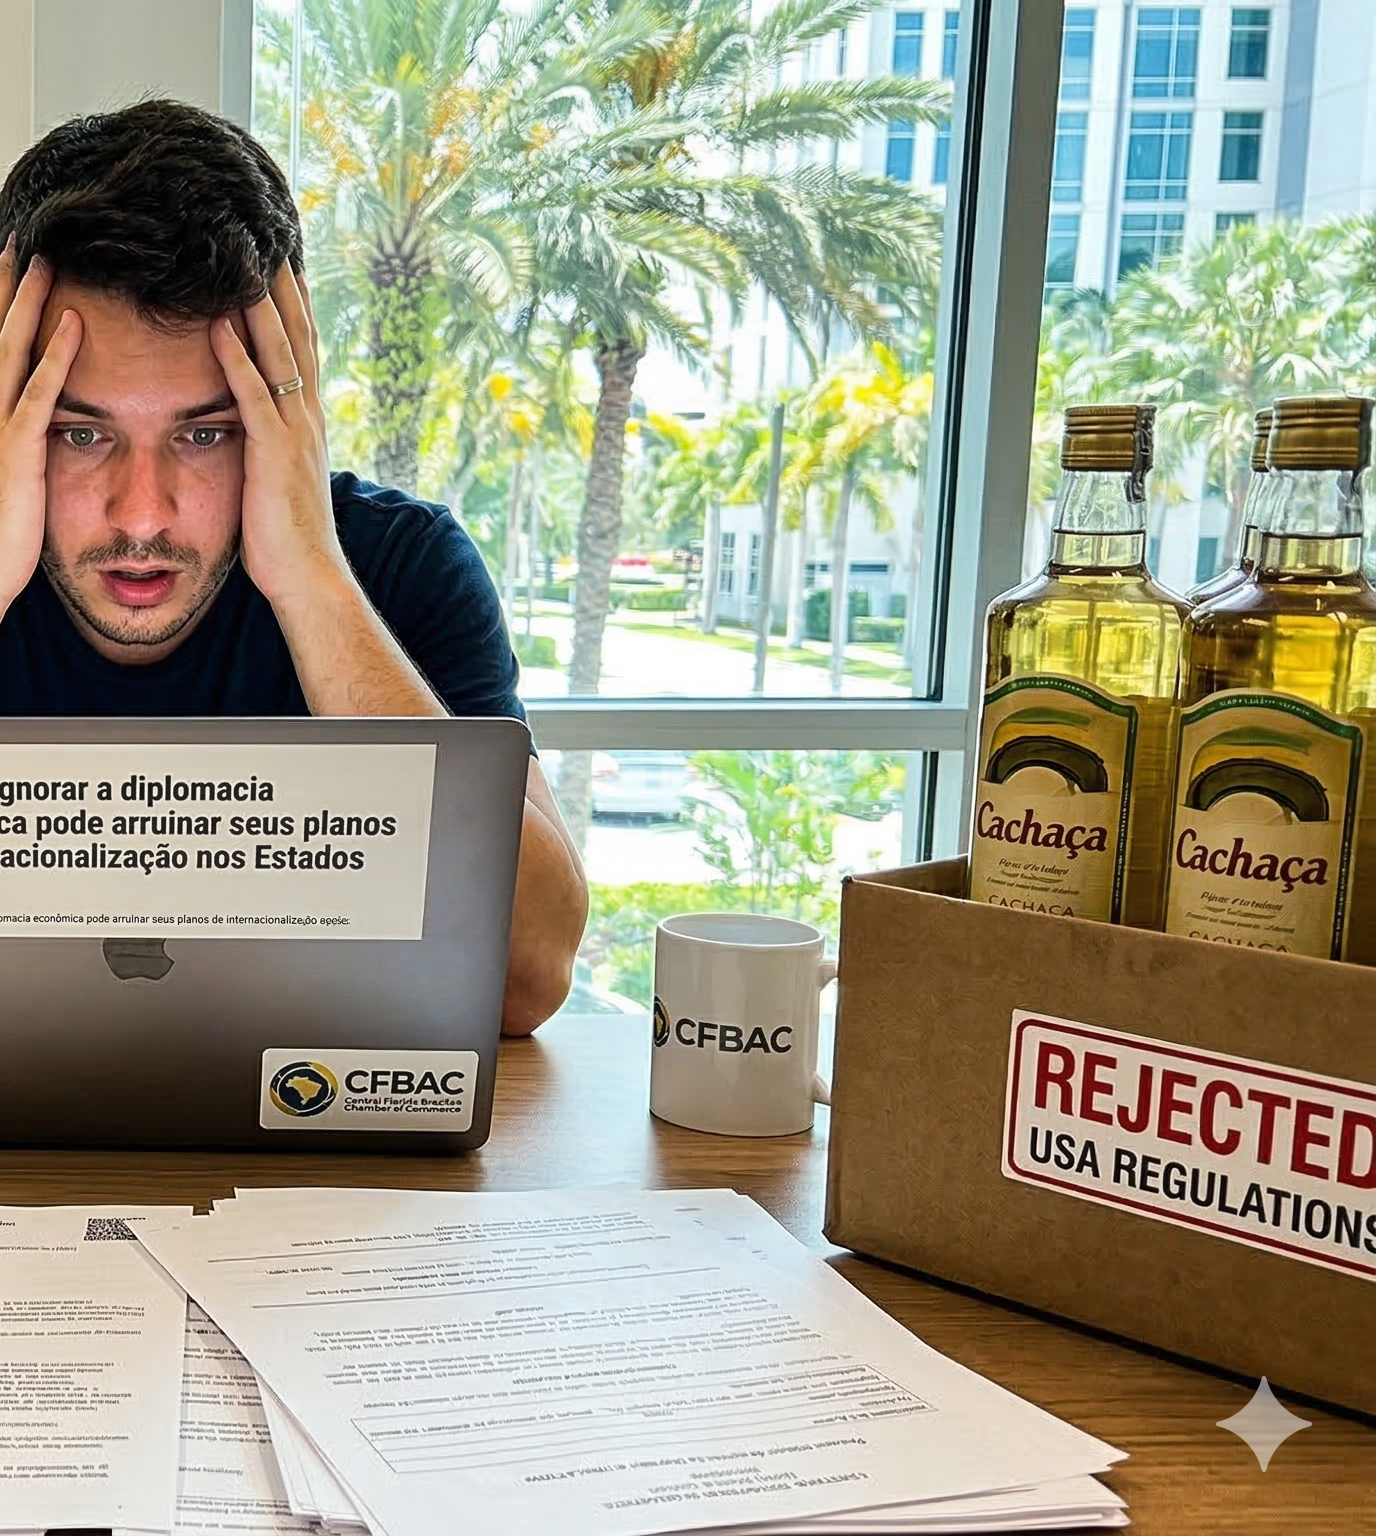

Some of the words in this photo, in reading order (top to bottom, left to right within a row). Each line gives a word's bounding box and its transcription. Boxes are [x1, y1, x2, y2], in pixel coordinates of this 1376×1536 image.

[97, 781, 112, 801] a
[121, 775, 274, 807] diplomacia
[36, 809, 104, 840] pode
[112, 810, 222, 835] arruinar
[229, 815, 294, 836] seus
[304, 810, 397, 842] planos
[977, 801, 1108, 859] Cachaça
[196, 849, 246, 869] nos
[255, 844, 365, 870] Estados
[1176, 828, 1329, 893] Cachaça
[33, 913, 84, 923] econômica
[86, 914, 110, 925] pode
[177, 914, 210, 925] planos
[212, 914, 224, 924] de
[676, 1018, 793, 1054] CFBAC
[345, 1070, 465, 1095] CFBAC
[344, 1104, 392, 1112] Chamber
[394, 1104, 404, 1112] of
[1034, 1041, 1376, 1190] REJECTED
[1030, 1126, 1100, 1178] USA
